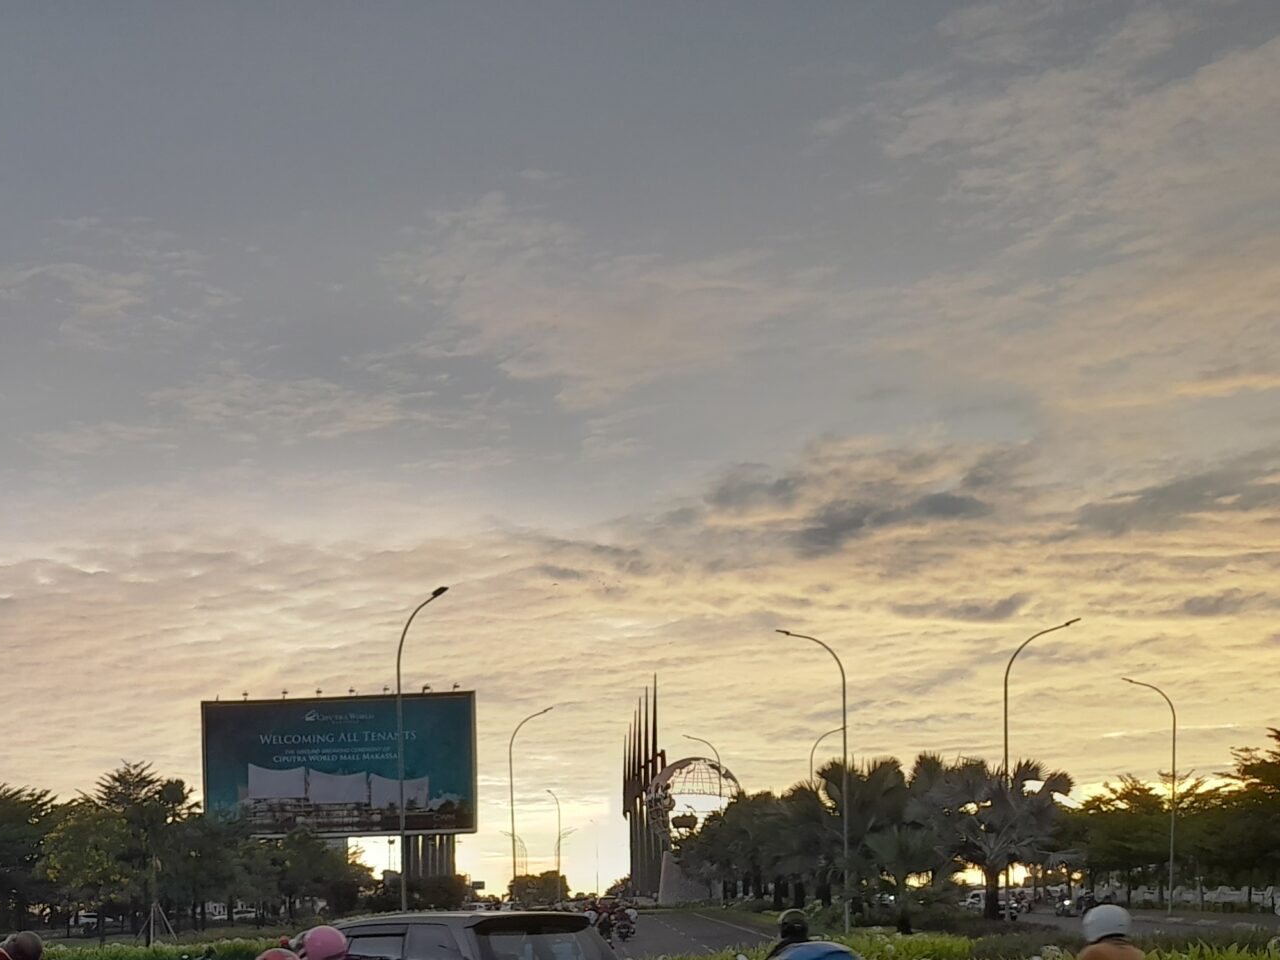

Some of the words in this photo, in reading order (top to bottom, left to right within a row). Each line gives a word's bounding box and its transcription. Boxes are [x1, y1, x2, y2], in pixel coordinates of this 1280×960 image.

[259, 733, 335, 745] WELCOMING
[338, 732, 359, 742] ALL
[273, 755, 306, 763] CIPUTRA
[308, 754, 338, 762] WORLD
[362, 751, 400, 760] MAKASSA
